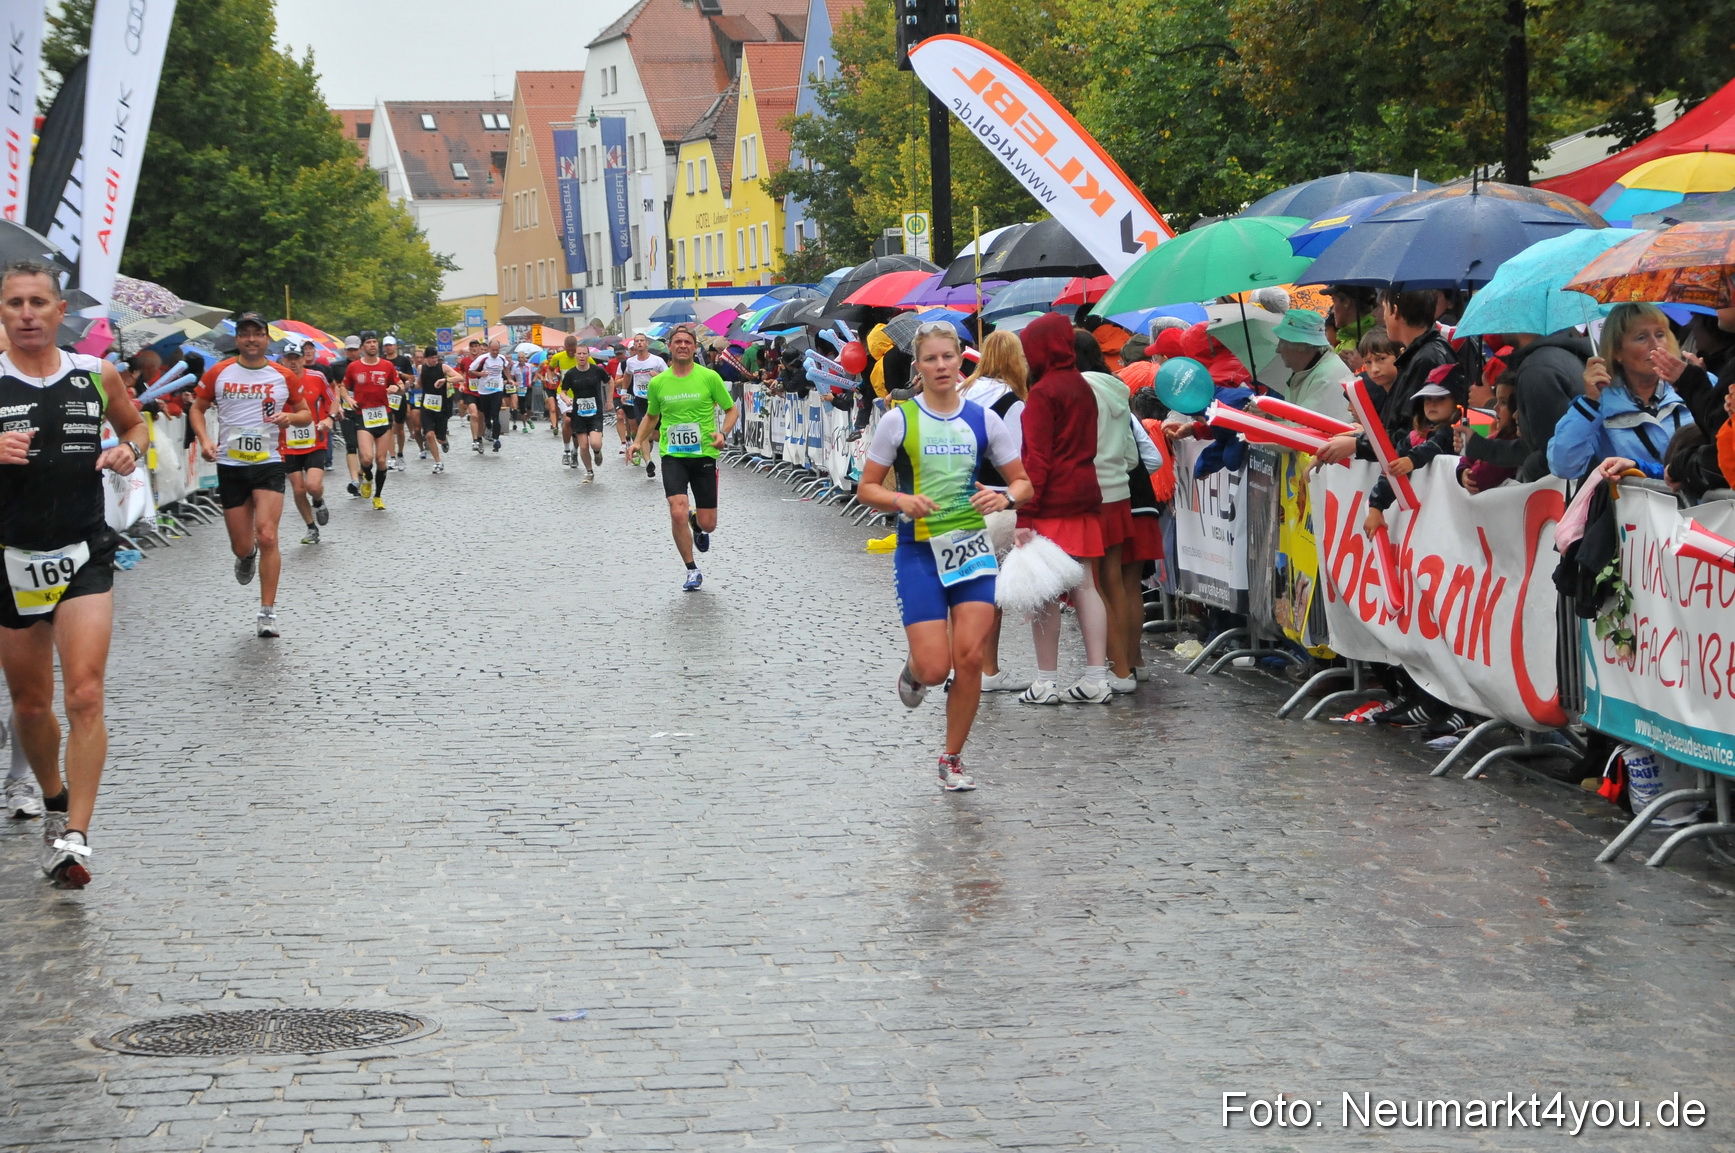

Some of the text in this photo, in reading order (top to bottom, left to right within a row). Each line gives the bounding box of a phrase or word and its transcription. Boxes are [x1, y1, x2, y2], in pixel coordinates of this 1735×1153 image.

[3, 22, 25, 222] Audi BKK
[97, 80, 133, 255] Audi BKK
[615, 173, 627, 225] RUPPERT
[223, 382, 274, 394] MERZ
[367, 411, 383, 420] 246
[292, 428, 309, 439] 139
[670, 431, 698, 445] 3165
[237, 437, 262, 452] 166
[924, 444, 971, 455] BOCK
[941, 534, 990, 570] 2258
[24, 556, 75, 588] 169
